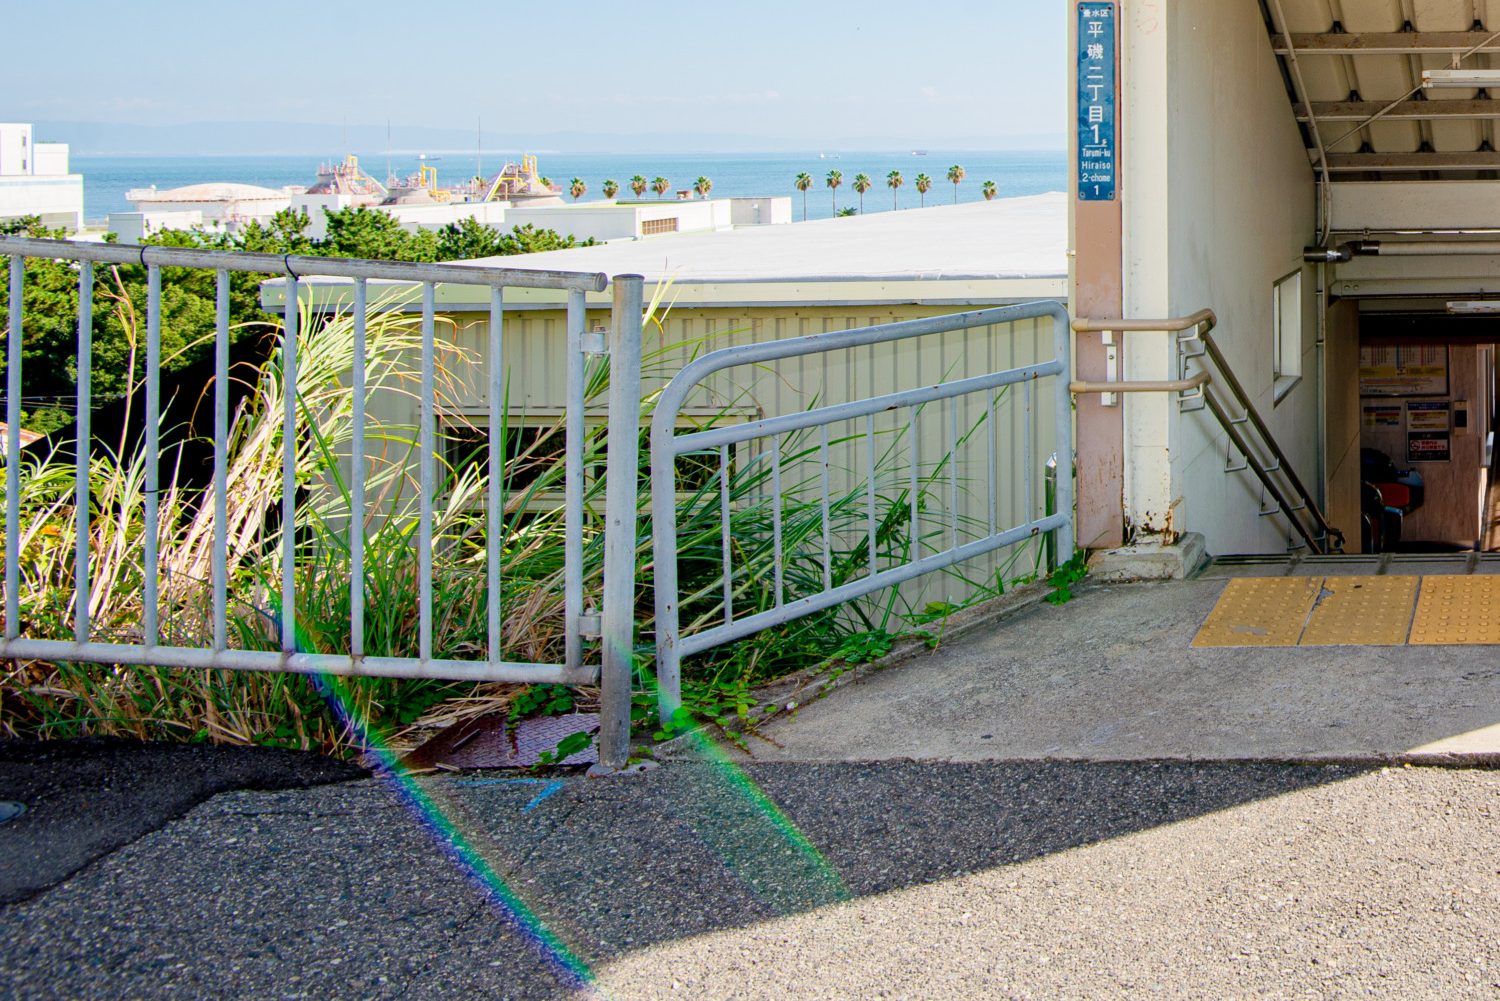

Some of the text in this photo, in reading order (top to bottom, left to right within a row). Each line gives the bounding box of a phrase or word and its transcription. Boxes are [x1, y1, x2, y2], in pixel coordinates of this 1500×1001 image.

[1082, 148, 1111, 157] Tarumi-ku
[1081, 161, 1111, 170] Hiraiso
[1082, 173, 1111, 182] 2-chome
